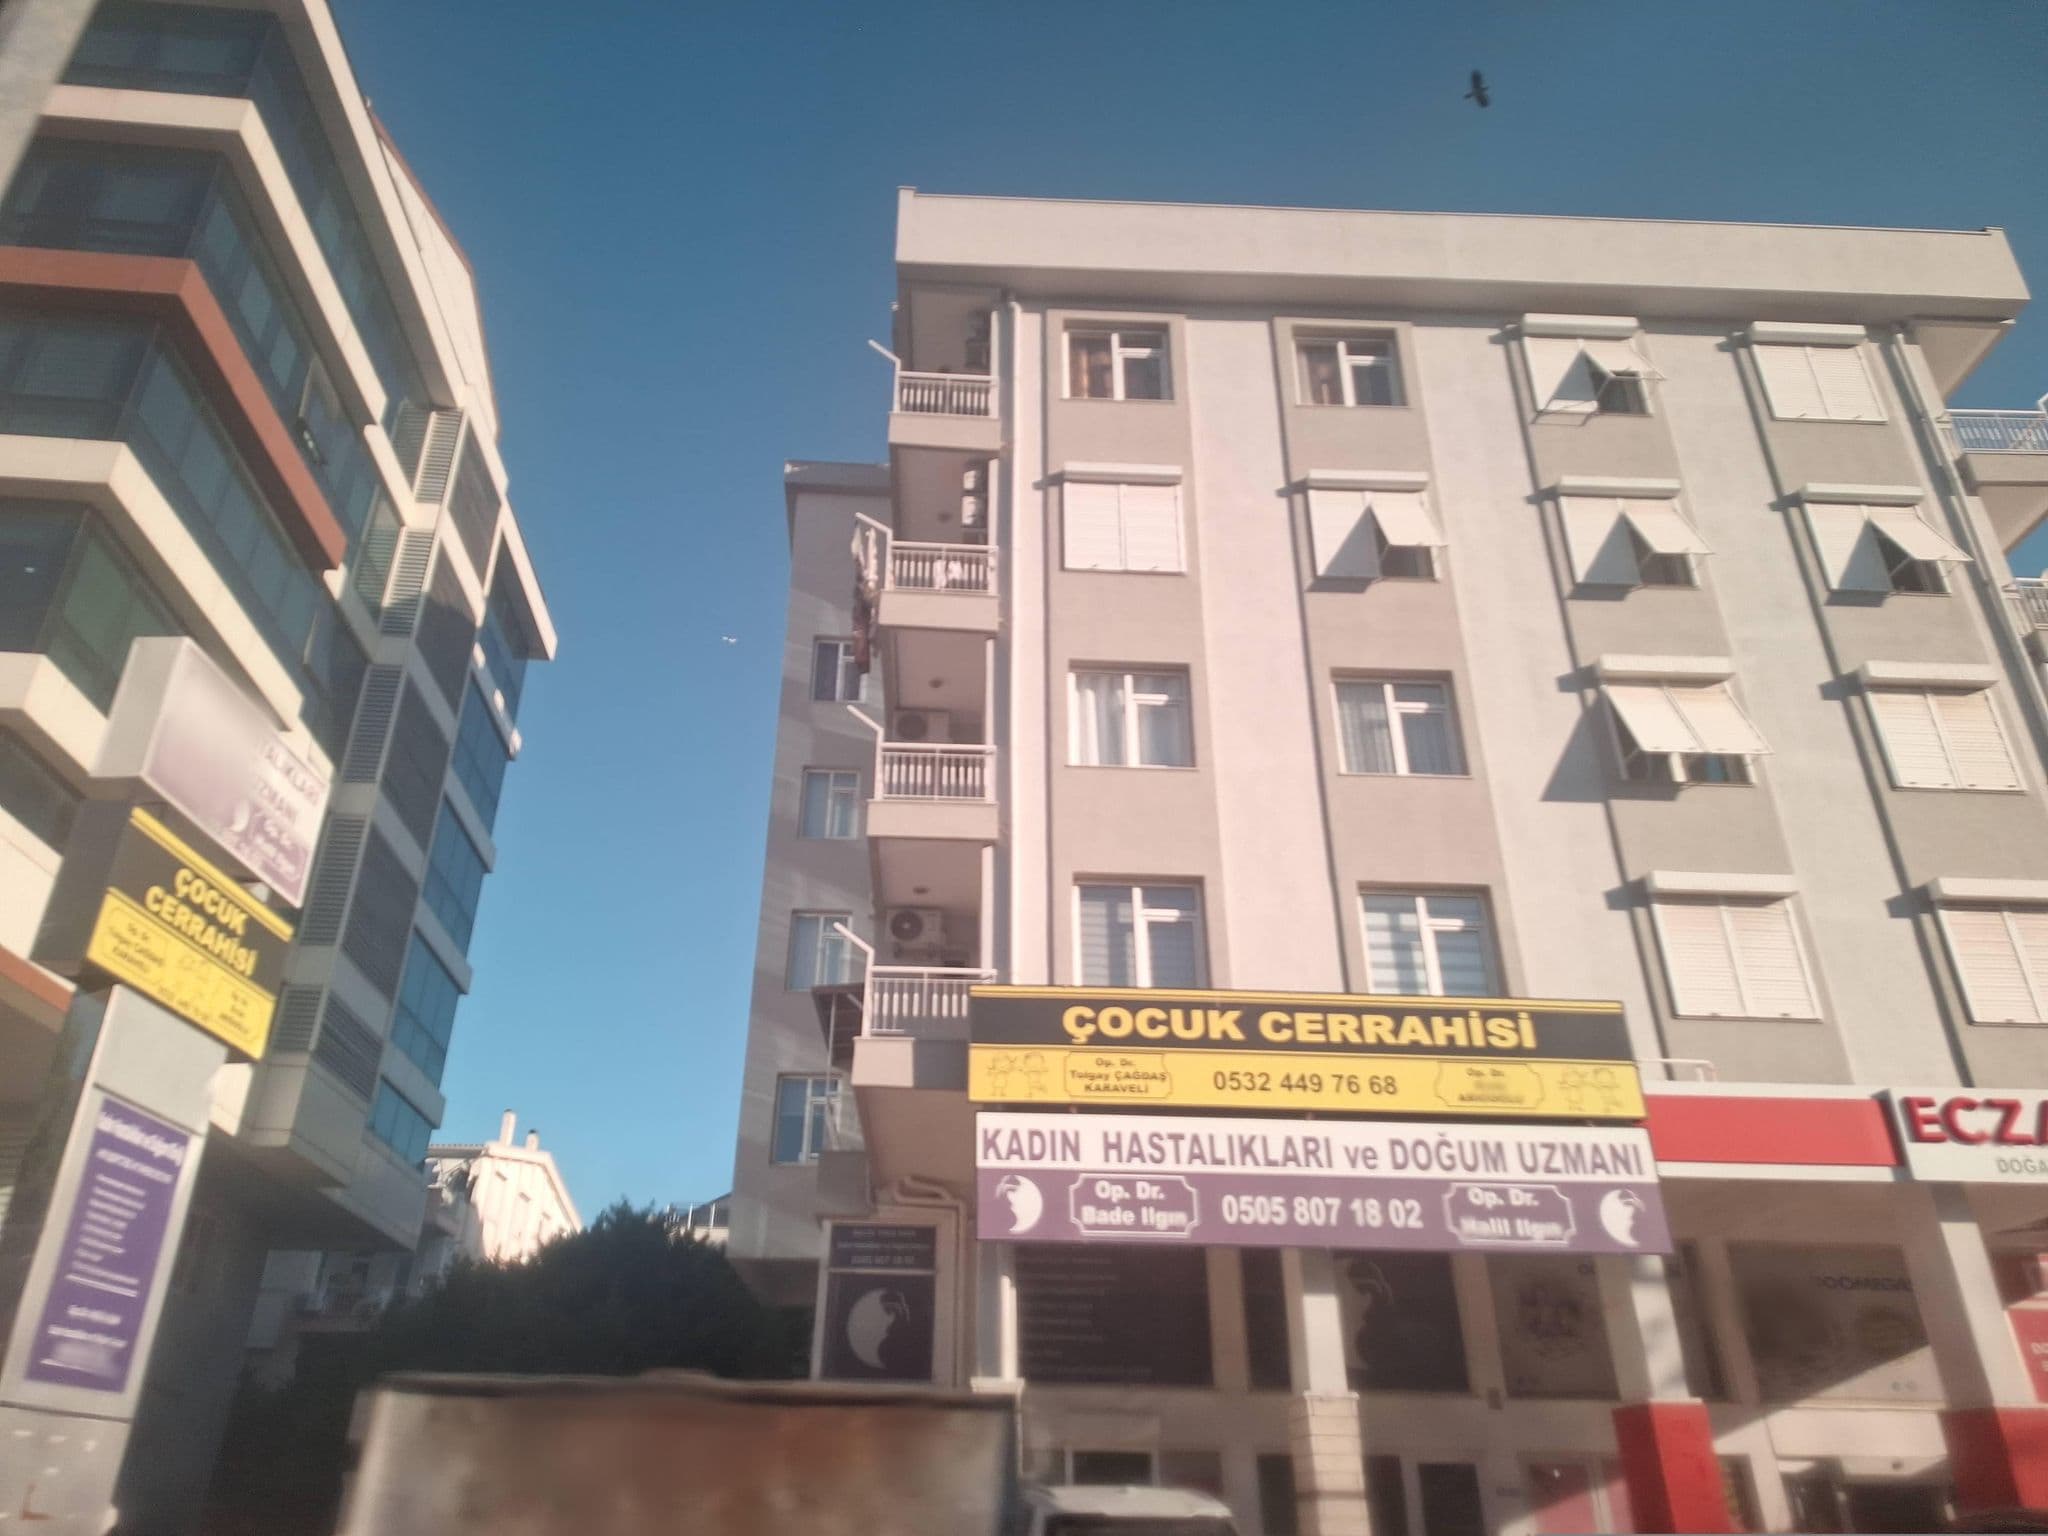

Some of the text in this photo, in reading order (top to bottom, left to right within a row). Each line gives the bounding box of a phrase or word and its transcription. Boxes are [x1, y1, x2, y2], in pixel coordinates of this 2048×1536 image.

[174, 867, 249, 933] ÇOCUK
[145, 886, 258, 976] CERRAHİSİ
[1062, 1005, 1537, 1050] ÇOCUK CERRAHİSİ
[1214, 1071, 1398, 1095] 0532 449 76 68
[1903, 1096, 2048, 1147] ECZ
[982, 1127, 1645, 1176] KADIN HASTALIKLARI ve DOĞUM UZMANI
[1095, 1180, 1166, 1204] Op. Dr.
[1221, 1195, 1424, 1229] 0505 807 18 02
[1467, 1186, 1540, 1209] Op. Dr.
